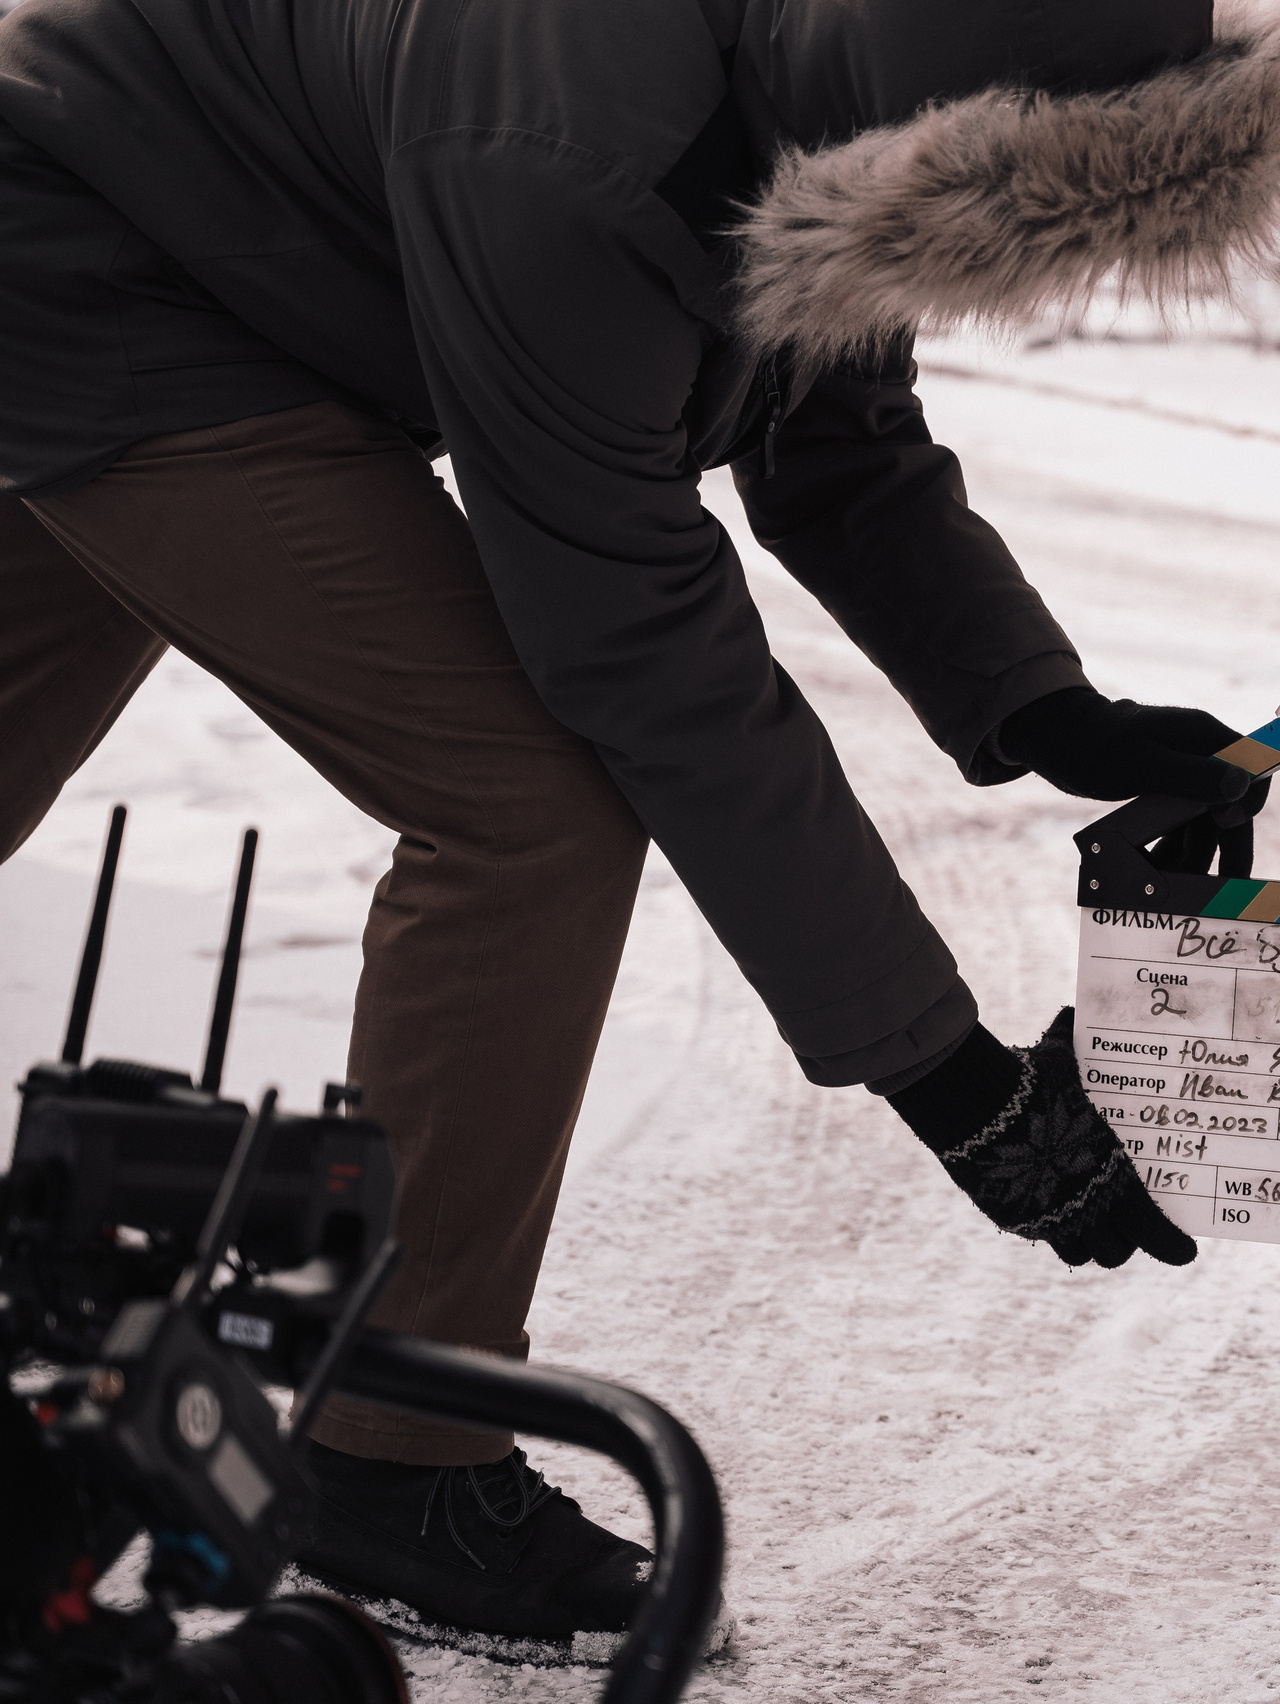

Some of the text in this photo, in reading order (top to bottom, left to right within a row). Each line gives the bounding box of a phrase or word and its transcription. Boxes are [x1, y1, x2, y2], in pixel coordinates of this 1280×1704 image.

[1091, 908, 1175, 931] ФИЛЬМ
[1174, 917, 1248, 960] Всё
[1135, 967, 1189, 988] Сцена
[1150, 987, 1188, 1017] 2
[1091, 1036, 1169, 1061] Режиссер
[1178, 1039, 1250, 1068] Юлия
[1086, 1068, 1167, 1091] Оператор
[1178, 1070, 1250, 1102] Иван
[1098, 1106, 1125, 1119] ата
[1156, 1133, 1208, 1161] Mist
[1224, 1180, 1252, 1197] WB
[1221, 1207, 1251, 1225] ISO
